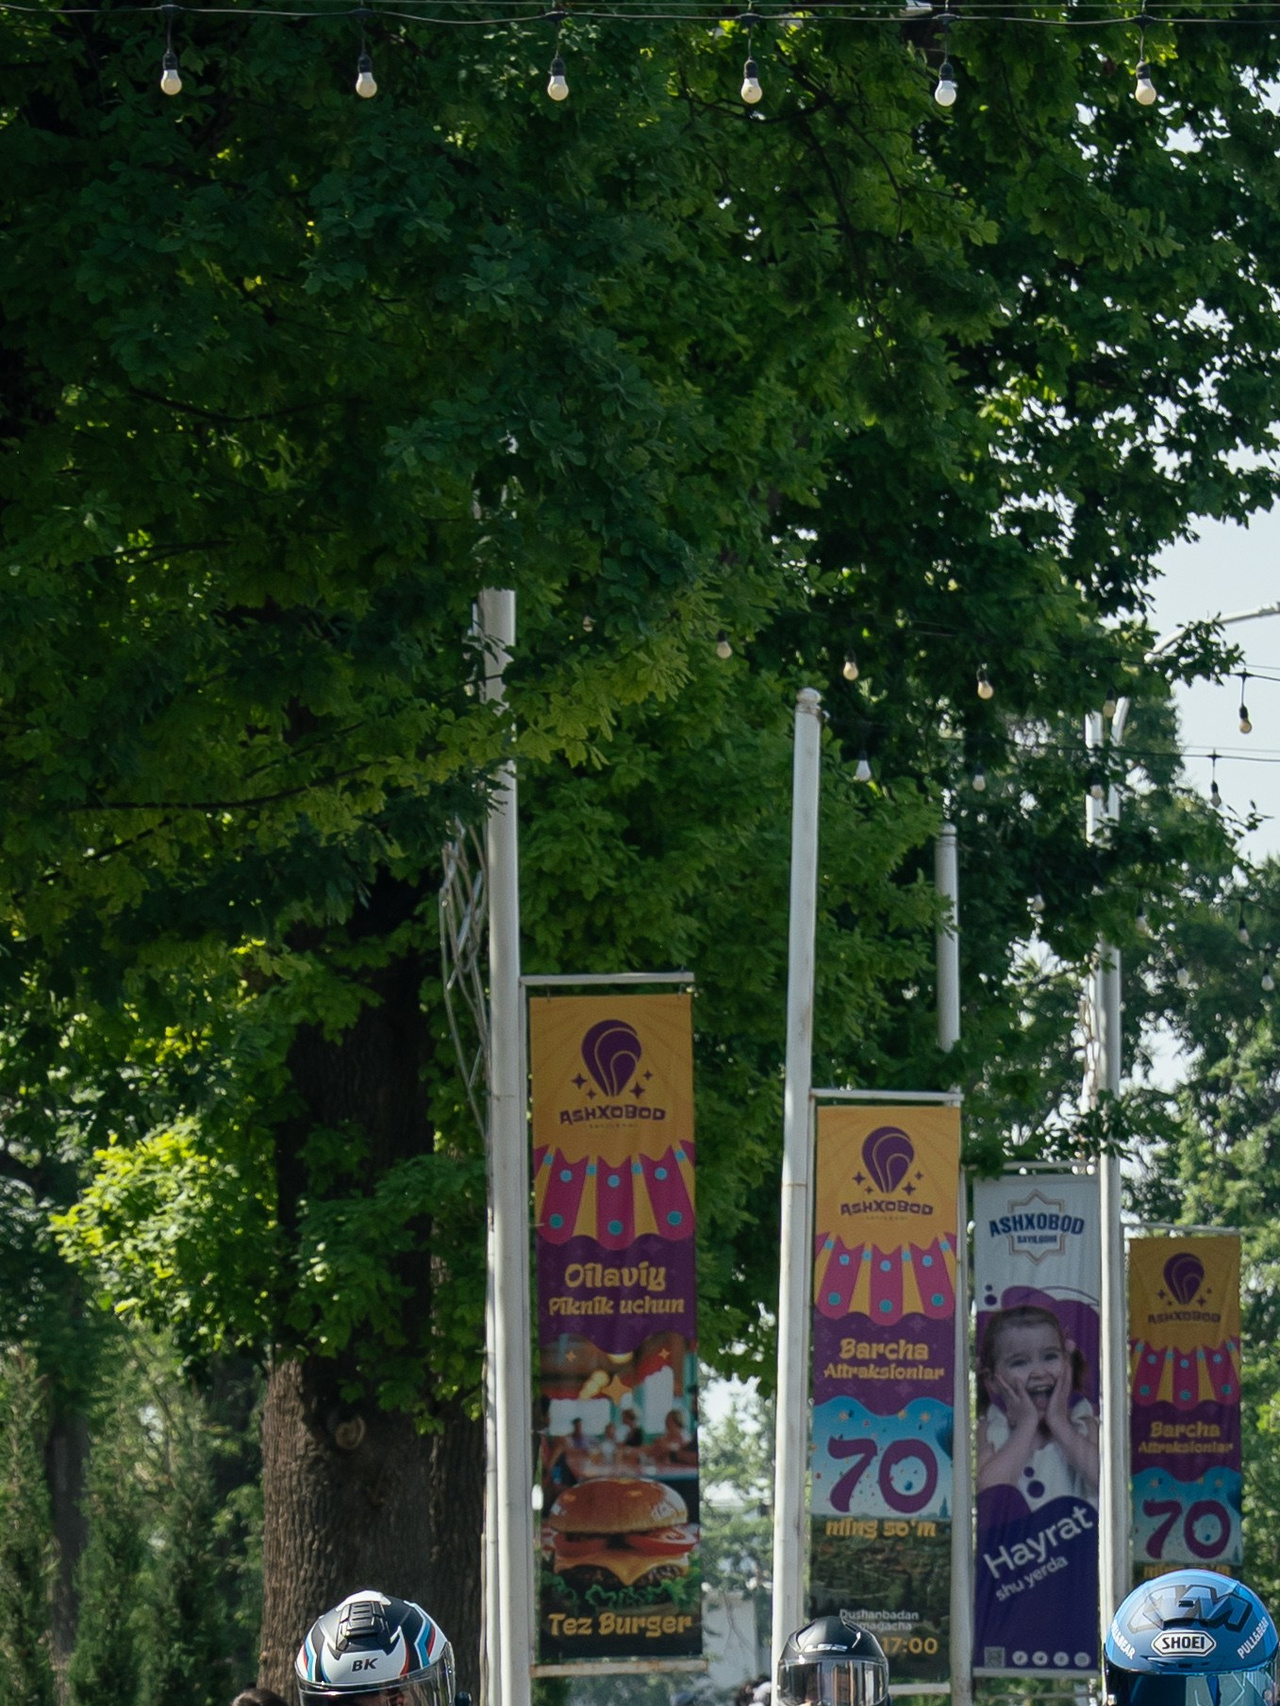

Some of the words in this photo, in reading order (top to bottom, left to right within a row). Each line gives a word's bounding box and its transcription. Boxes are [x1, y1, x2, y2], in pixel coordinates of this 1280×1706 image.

[559, 1103, 666, 1126] ASHXOBOD
[840, 1200, 934, 1216] ASHXOBOD
[988, 1212, 1085, 1238] ASHXOBOD
[564, 1261, 666, 1291] Oilaviy
[548, 1296, 614, 1316] Piknik
[620, 1295, 685, 1314] uchun
[839, 1337, 929, 1360] Barcha
[823, 1363, 945, 1380] Attraksionlar
[1151, 1421, 1221, 1438] Barcha
[827, 1434, 938, 1514] 70
[825, 1517, 878, 1539] ming
[1143, 1499, 1231, 1559] 70
[983, 1505, 1094, 1579] Hayrat
[995, 1578, 1025, 1601] shu
[1024, 1555, 1069, 1589] yerda
[548, 1613, 593, 1636] Tez
[598, 1612, 692, 1638] Burger
[839, 1609, 919, 1621] Dushanbadan
[1162, 1636, 1205, 1650] SHOEI
[351, 1657, 379, 1672] BK
